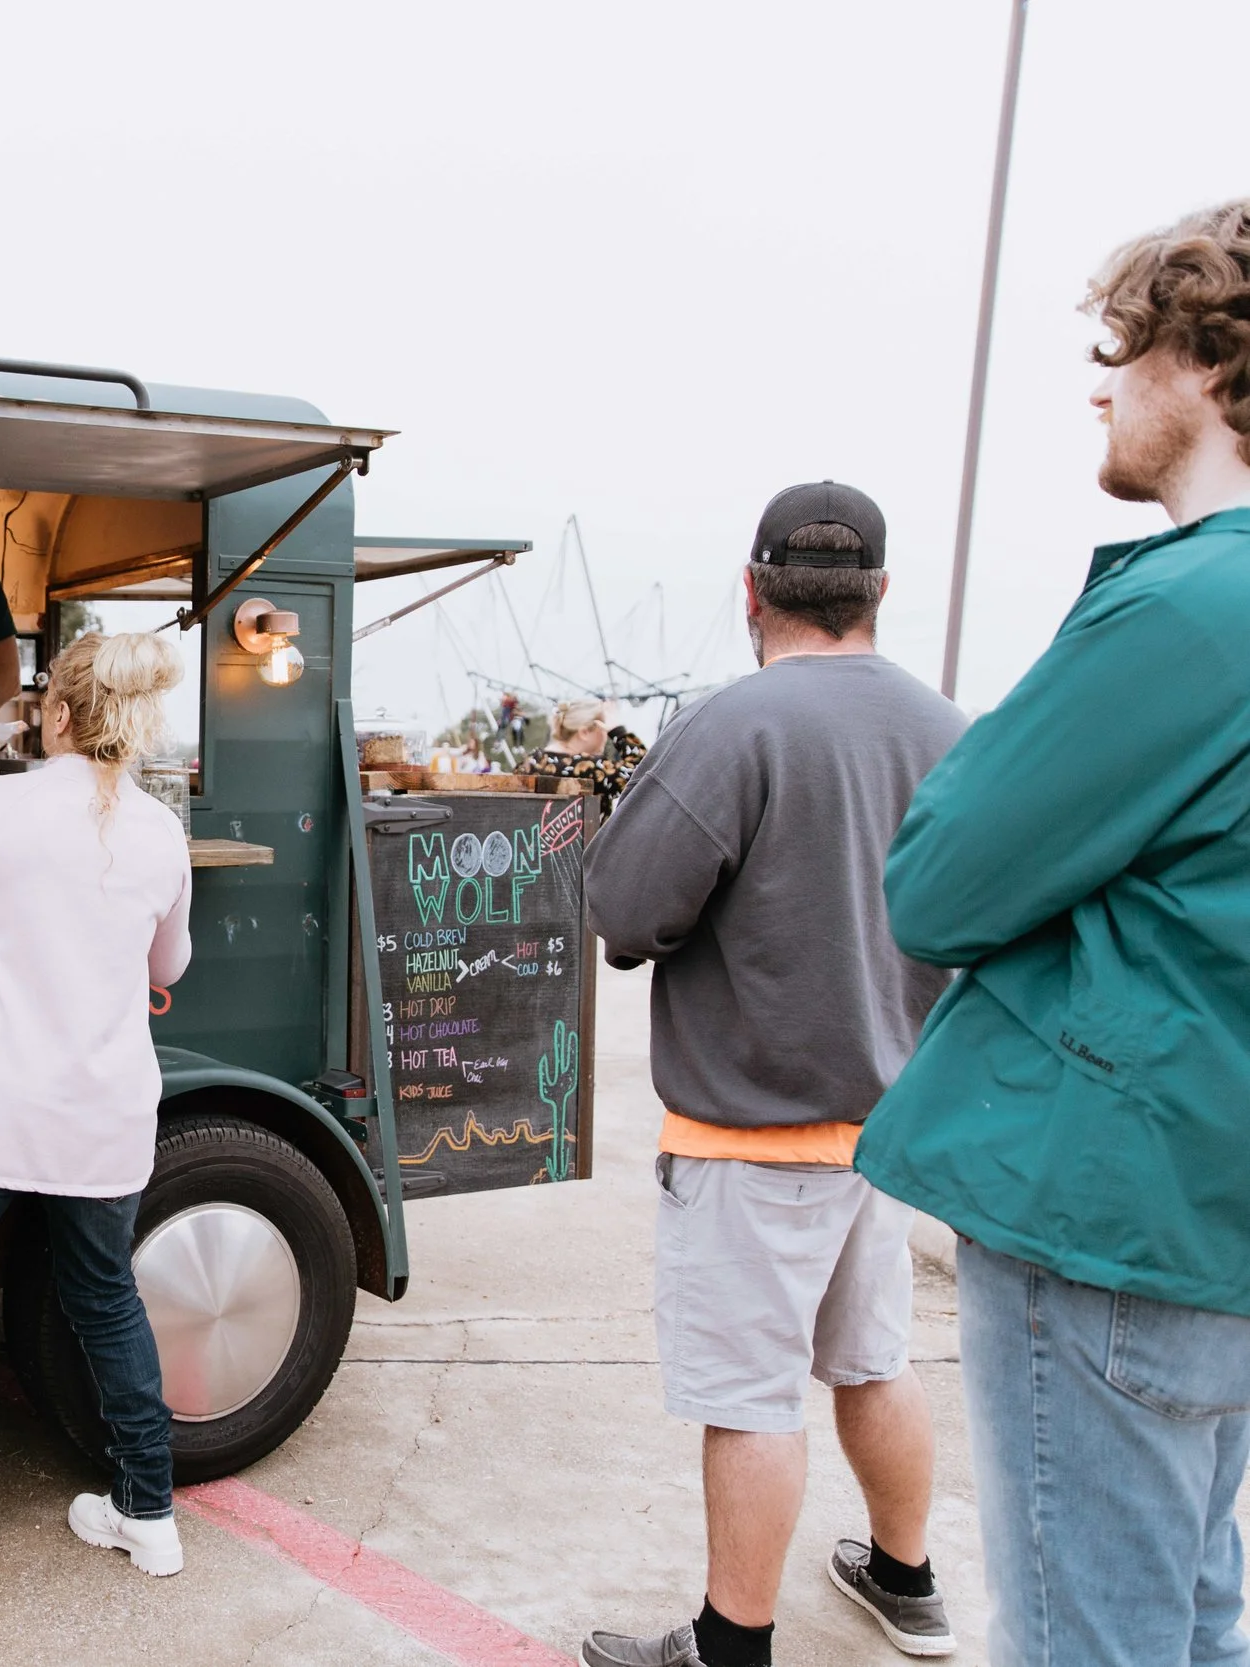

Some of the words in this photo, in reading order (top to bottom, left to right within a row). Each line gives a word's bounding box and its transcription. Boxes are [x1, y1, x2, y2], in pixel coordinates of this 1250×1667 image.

[408, 824, 542, 885] MOON
[412, 875, 537, 927] WOLF
[376, 934, 398, 953] $5
[404, 931, 433, 950] COLD
[437, 926, 467, 946] BREW
[516, 941, 540, 959] HOT
[547, 936, 565, 954] $5
[406, 948, 459, 975] HAZELNUT
[516, 962, 539, 977] COLD
[546, 960, 563, 976] $6
[406, 971, 452, 994] VANILLA
[400, 999, 426, 1019] HOT
[430, 996, 456, 1018] DRIP
[400, 1023, 426, 1041] HOT
[429, 1018, 480, 1039] CHOCOLATE
[401, 1050, 429, 1070] HOT
[433, 1046, 457, 1067] TEA
[399, 1083, 424, 1100] KIDS
[426, 1084, 453, 1099] JUICE
